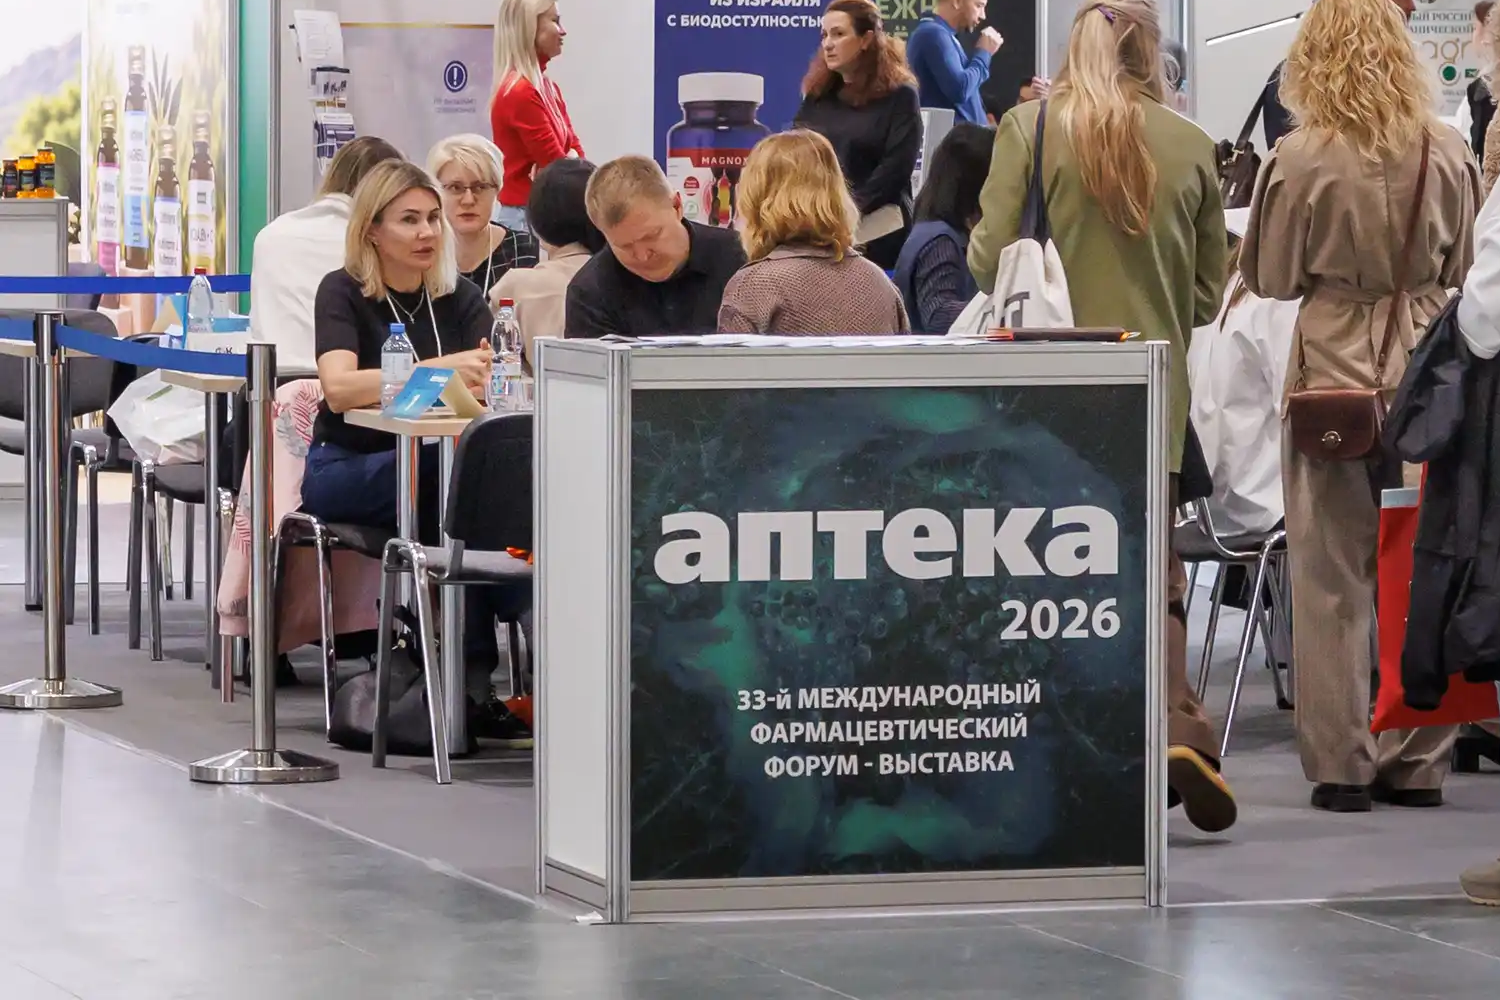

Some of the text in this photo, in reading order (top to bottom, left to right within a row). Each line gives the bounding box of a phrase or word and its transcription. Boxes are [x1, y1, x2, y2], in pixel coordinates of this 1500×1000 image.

[667, 14, 677, 27] С
[653, 505, 1119, 585] аптека
[1000, 597, 1121, 641] 2026
[737, 678, 1041, 712] 33-й МЕЖДУНАРОДНЫЙ
[750, 712, 1028, 746] ФАРМАЦЕВТИЧЕСКИЙ
[764, 754, 858, 778] ФОРУМ
[879, 750, 1014, 775] ВЫСТАВКА
